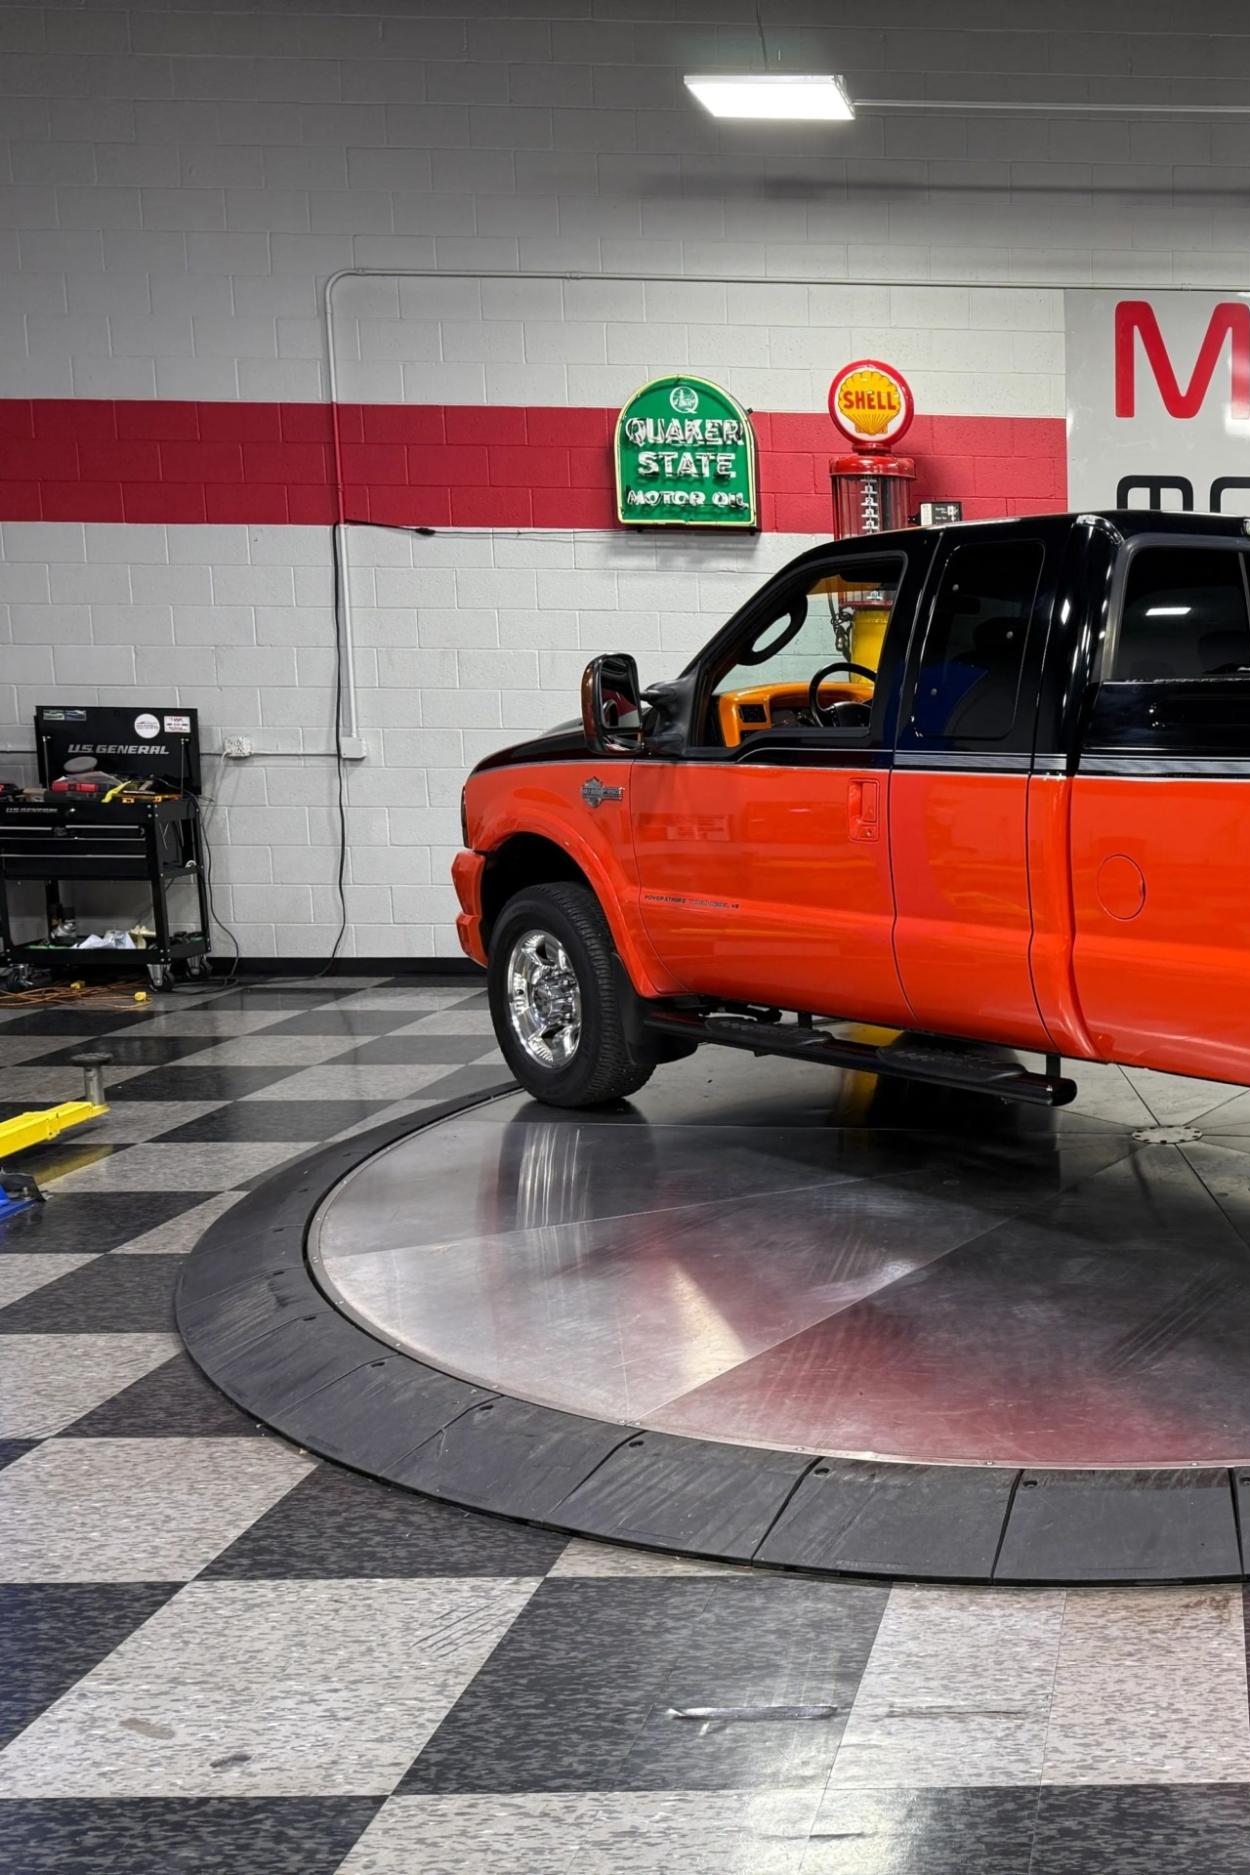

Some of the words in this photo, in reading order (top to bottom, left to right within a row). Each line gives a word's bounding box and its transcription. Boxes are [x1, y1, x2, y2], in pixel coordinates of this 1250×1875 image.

[843, 390, 898, 411] SHELL
[625, 417, 745, 447] QUAKER
[637, 451, 737, 478] STATE
[627, 489, 707, 507] MOTOR
[712, 491, 749, 509] OIL
[95, 744, 170, 756] GENERAL
